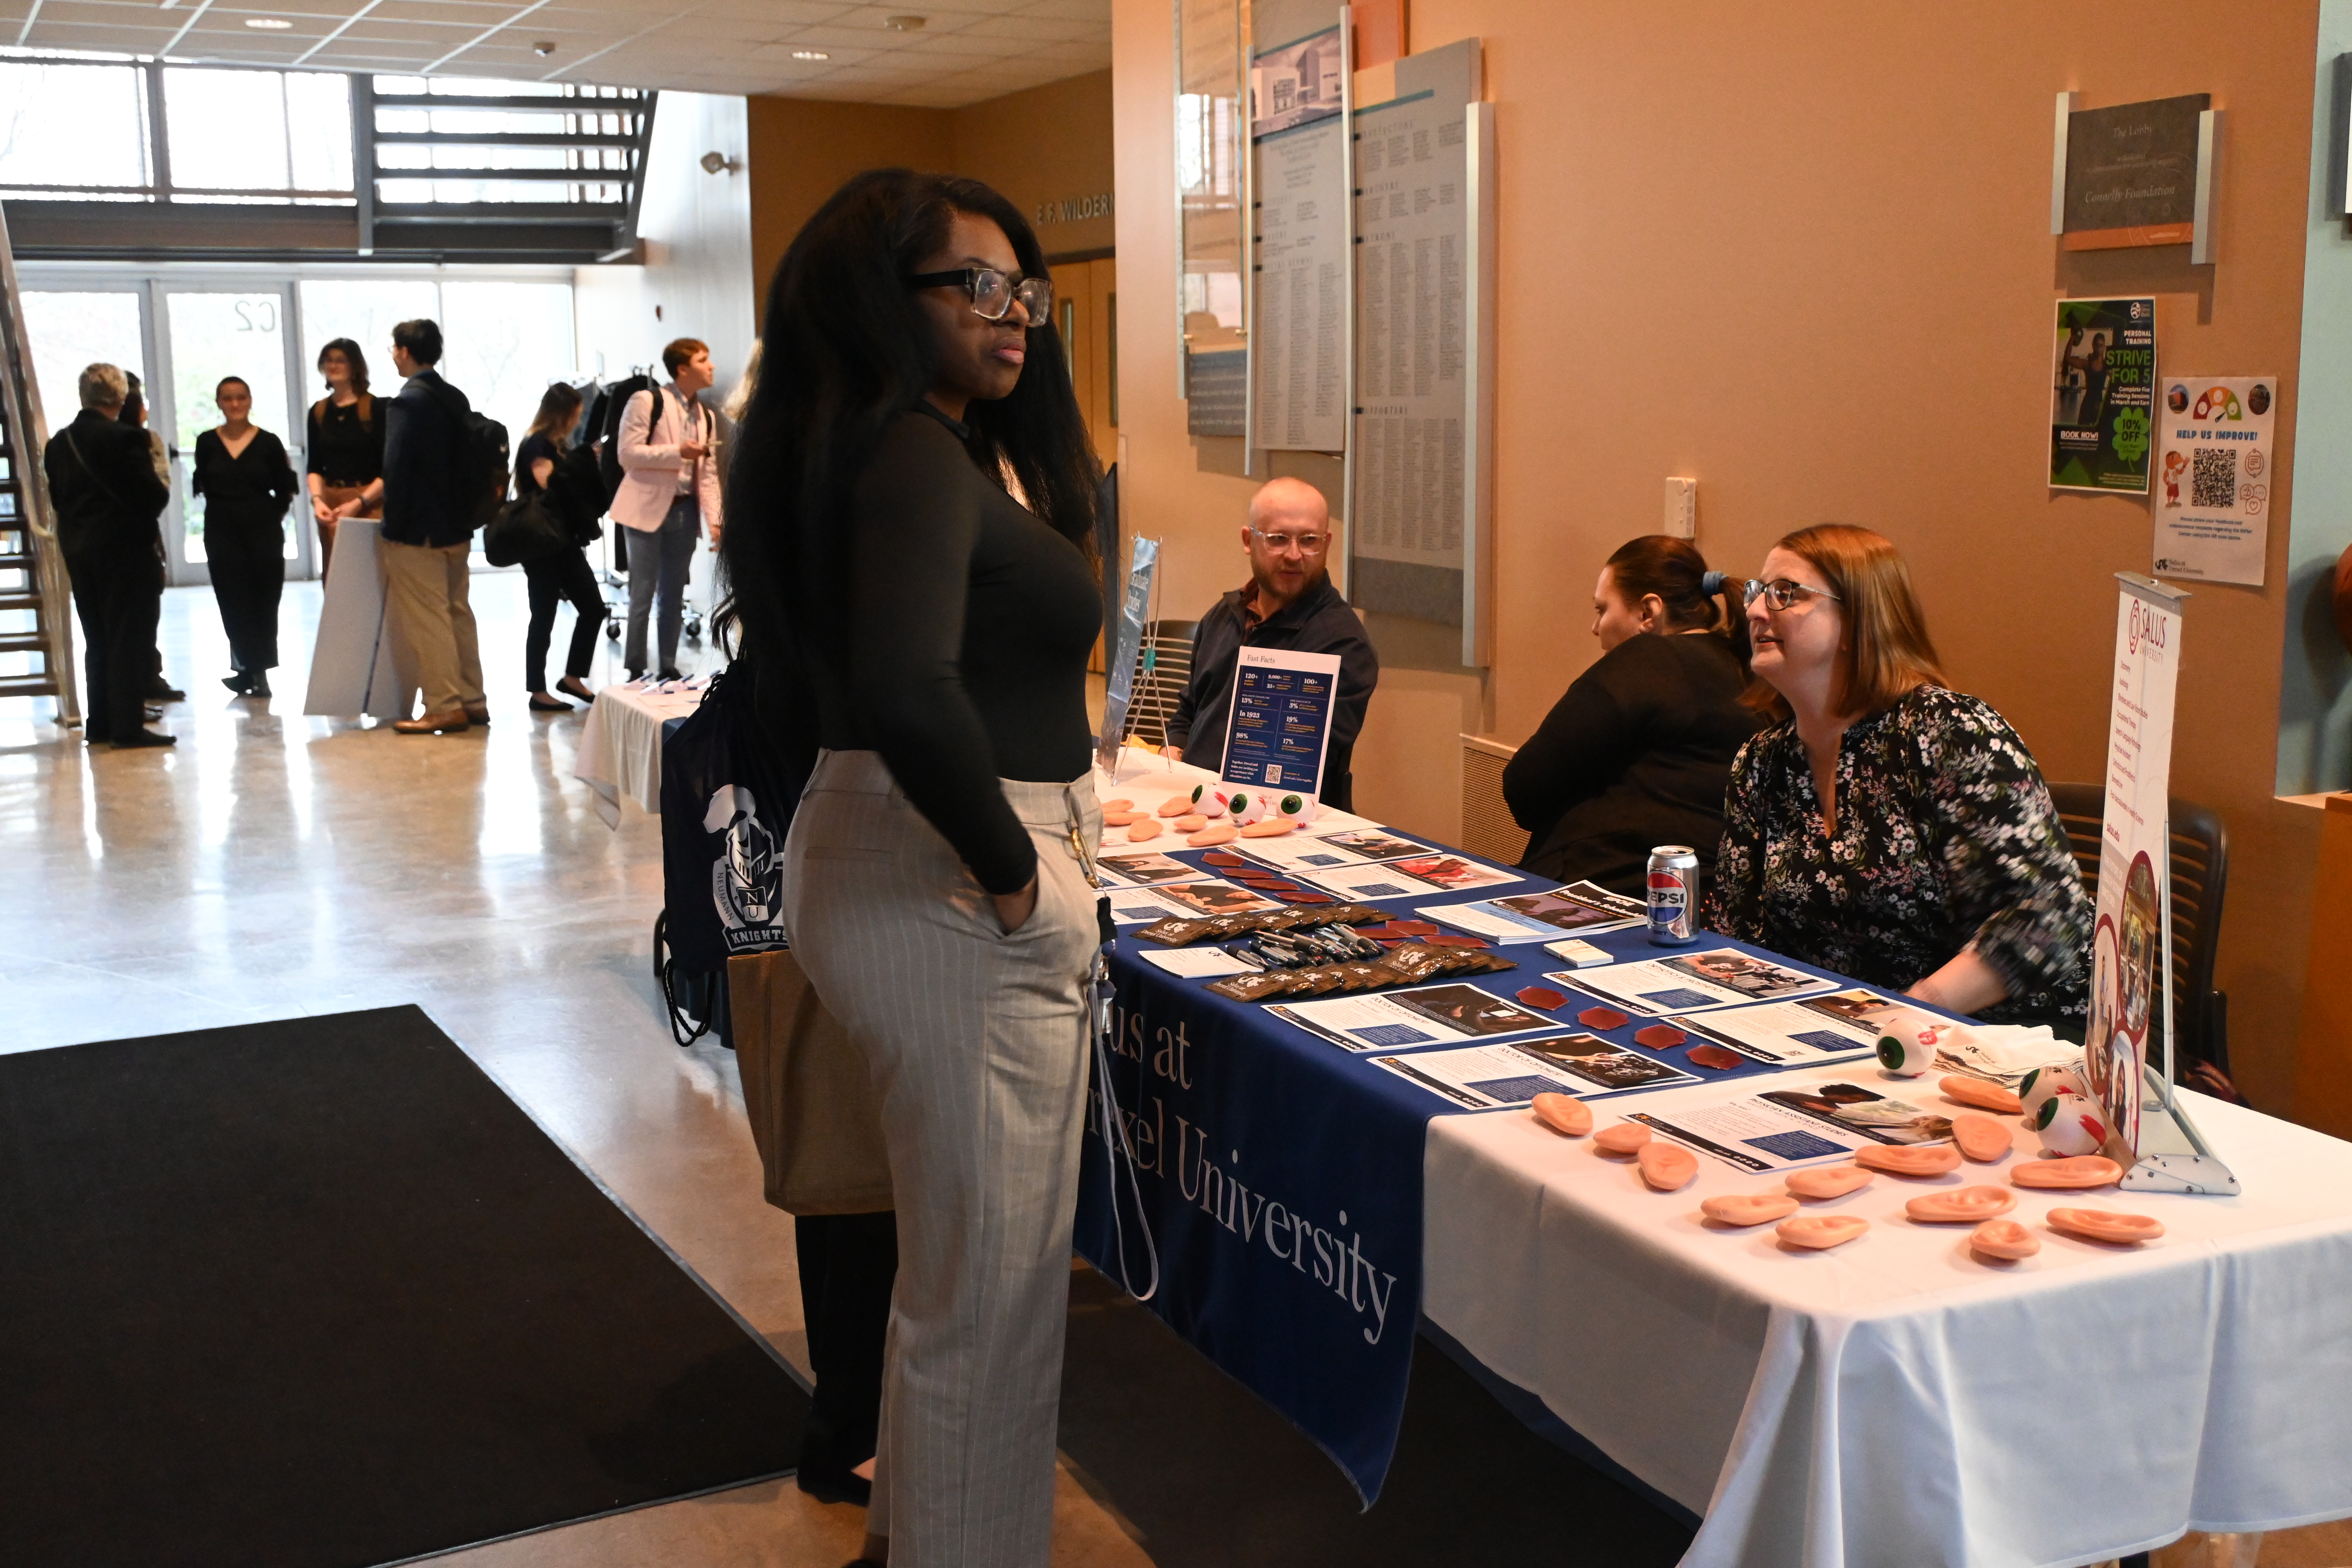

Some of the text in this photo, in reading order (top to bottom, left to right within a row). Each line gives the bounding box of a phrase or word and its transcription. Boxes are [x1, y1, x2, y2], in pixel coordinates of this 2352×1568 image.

[2113, 125, 2151, 138] The Lobby
[2085, 185, 2175, 203] Connelly Foundation
[2106, 350, 2151, 366] STRIVE
[2112, 368, 2150, 384] FOR 5
[2123, 419, 2141, 430] 10%
[2121, 431, 2140, 442] OFF
[2177, 430, 2258, 441] HELP US IMPROVE!
[2141, 608, 2166, 648] SALUS
[2140, 644, 2163, 664] UNIVERSITY
[2107, 822, 2120, 842] salus.edu
[717, 872, 734, 920] NEUMANN
[746, 892, 758, 903] N
[1559, 890, 1601, 905] President's
[1603, 896, 1635, 906] SEPCHE
[748, 907, 759, 918] U
[1156, 932, 1178, 942] University
[1227, 985, 1247, 997] University
[1366, 997, 1398, 1007] DOCTOR
[1396, 1011, 1432, 1024] OPTOMETRY
[1154, 1021, 1192, 1090] at
[1496, 1048, 1525, 1058] DOCTOR
[1527, 1062, 1567, 1077] OPTOMETRY
[1747, 1098, 1849, 1136] PHYSICIAN ASSISTANT STUDIES
[1176, 1114, 1396, 1345] University
